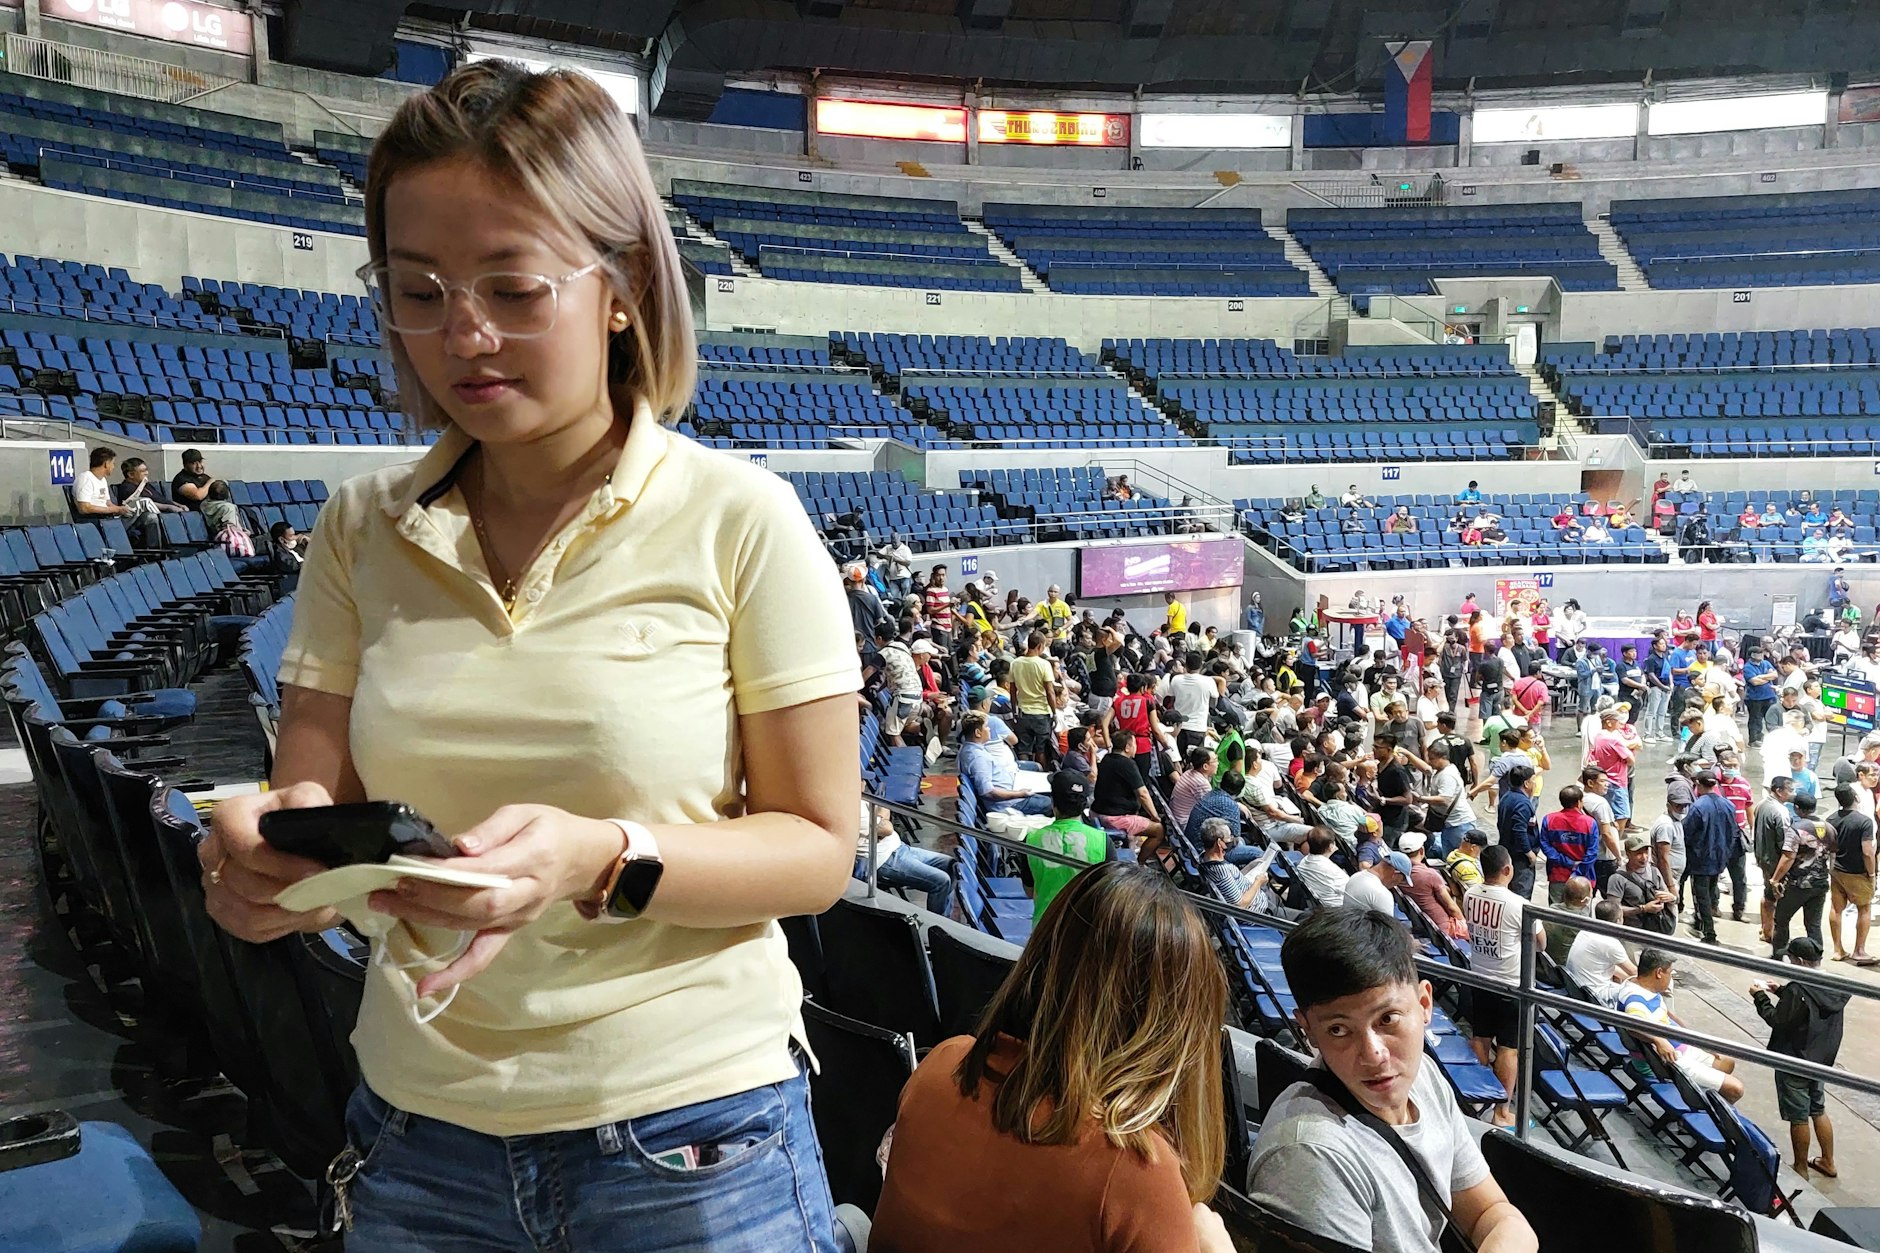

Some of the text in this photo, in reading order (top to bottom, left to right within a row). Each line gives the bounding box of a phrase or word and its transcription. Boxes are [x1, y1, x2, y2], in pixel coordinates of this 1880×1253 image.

[192, 10, 223, 36] LG
[1762, 174, 1776, 182] 402
[293, 234, 313, 248] 219
[718, 281, 734, 291] 220
[927, 294, 941, 304] 221
[1734, 292, 1750, 301] 201
[1228, 301, 1243, 310] 200
[51, 455, 74, 478] 114
[1383, 468, 1400, 478] 117
[963, 558, 977, 572] 116
[1120, 698, 1142, 719] 67
[1467, 896, 1502, 929] FUBU
[1490, 930, 1499, 941] US
[1473, 945, 1499, 959] ORK
